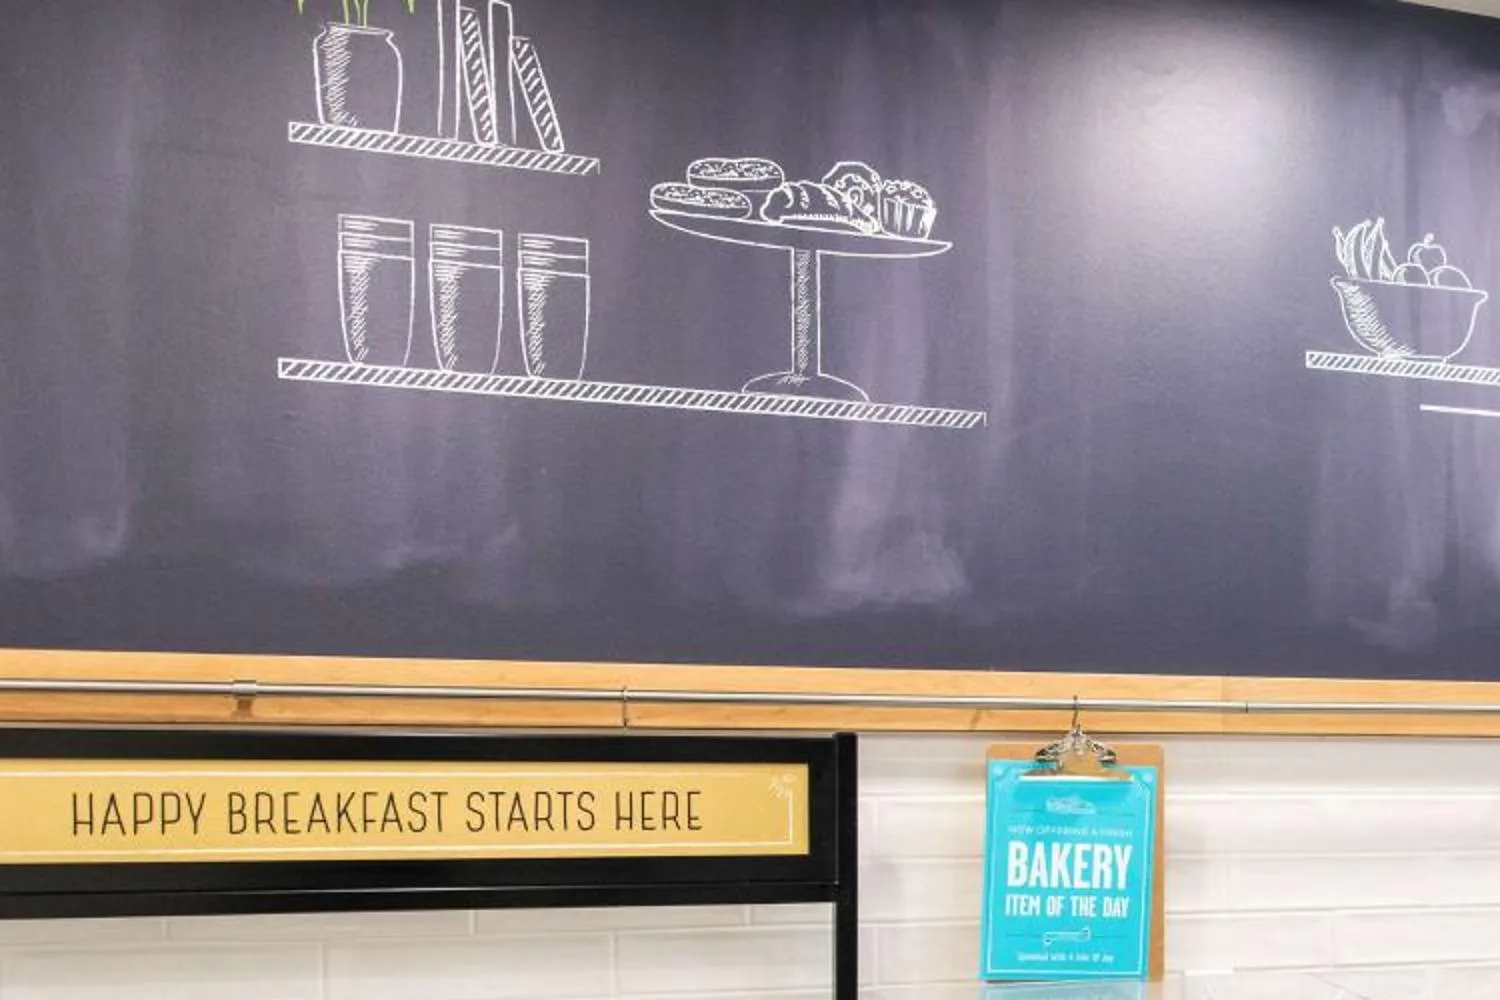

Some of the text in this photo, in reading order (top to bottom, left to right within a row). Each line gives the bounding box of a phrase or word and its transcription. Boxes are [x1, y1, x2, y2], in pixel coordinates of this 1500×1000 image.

[72, 791, 703, 837] HAPPY BREAKFAST STARTS HERE
[1007, 841, 1133, 890] BAKERY
[1005, 894, 1131, 919] ITEM OF THE DAY
